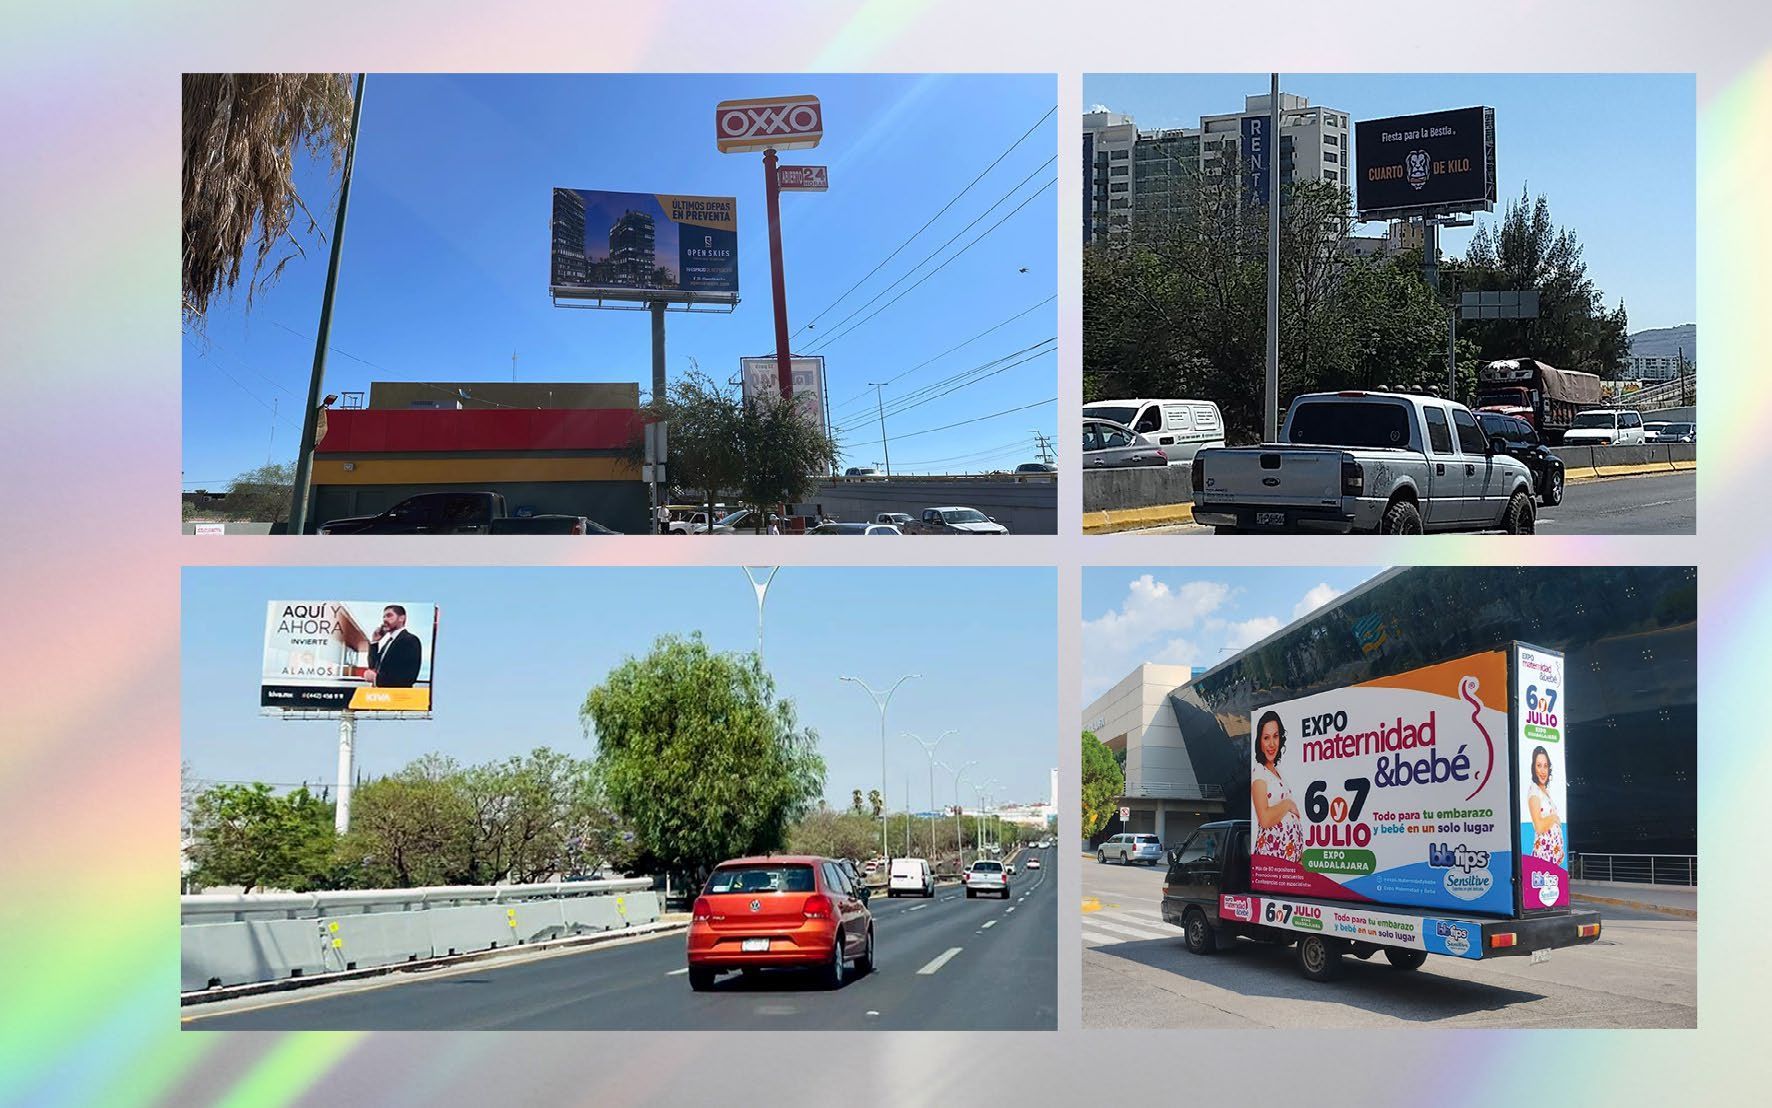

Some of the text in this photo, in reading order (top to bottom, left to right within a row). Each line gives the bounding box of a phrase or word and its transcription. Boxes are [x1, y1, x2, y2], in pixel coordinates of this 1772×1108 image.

[721, 105, 818, 137] OXXO
[1381, 132, 1402, 142] Fiesta
[1404, 131, 1420, 141] para
[1421, 128, 1429, 138] la
[804, 168, 825, 180] 24
[1368, 165, 1404, 181] CUARTO
[1433, 161, 1446, 174] DE
[672, 198, 731, 211] ÚLTIMOS DEPAS
[672, 210, 731, 221] EN PREVENTA
[687, 248, 730, 257] OPEN SKIES
[282, 603, 342, 618] AQUÍ Y
[277, 620, 343, 634] AHORA
[1522, 653, 1535, 661] EXPO
[281, 667, 333, 676] ALAMOS
[1522, 661, 1552, 673] maternidad
[1301, 711, 1348, 738] EXPO
[1526, 711, 1558, 727] JULIO
[1302, 711, 1436, 763] maternidad
[1374, 744, 1470, 788] &bebé
[1372, 808, 1493, 822] Todo para tu embarazo
[1304, 823, 1371, 847] JULIO
[1373, 821, 1494, 835] y bebé en un solo lugar
[1323, 850, 1345, 859] EXPO
[1308, 861, 1369, 871] GUADALAJARA
[1447, 875, 1490, 887] Sensitive
[1294, 905, 1321, 919] JULIO
[1334, 913, 1415, 931] Todo para tu embarazo
[1340, 923, 1357, 933] bebé
[1378, 930, 1394, 939] solo
[1395, 931, 1416, 942] lugar
